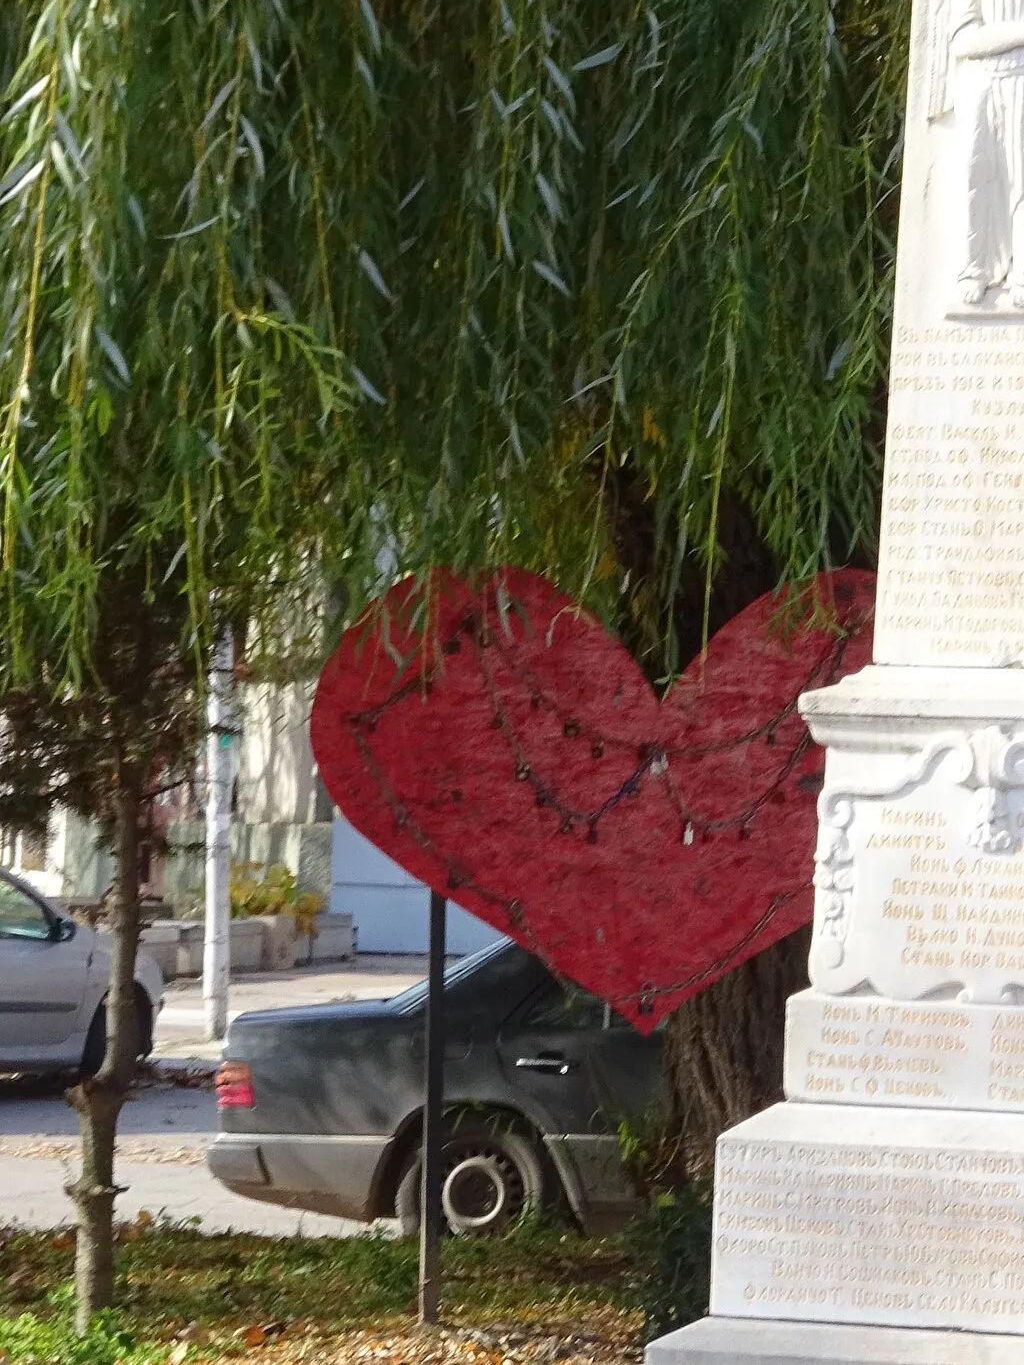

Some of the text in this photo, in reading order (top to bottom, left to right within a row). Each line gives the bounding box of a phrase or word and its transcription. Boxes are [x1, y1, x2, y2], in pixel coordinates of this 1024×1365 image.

[952, 375, 986, 392] 1912
[992, 376, 1003, 391] И
[880, 805, 946, 827] МАРИНЪ
